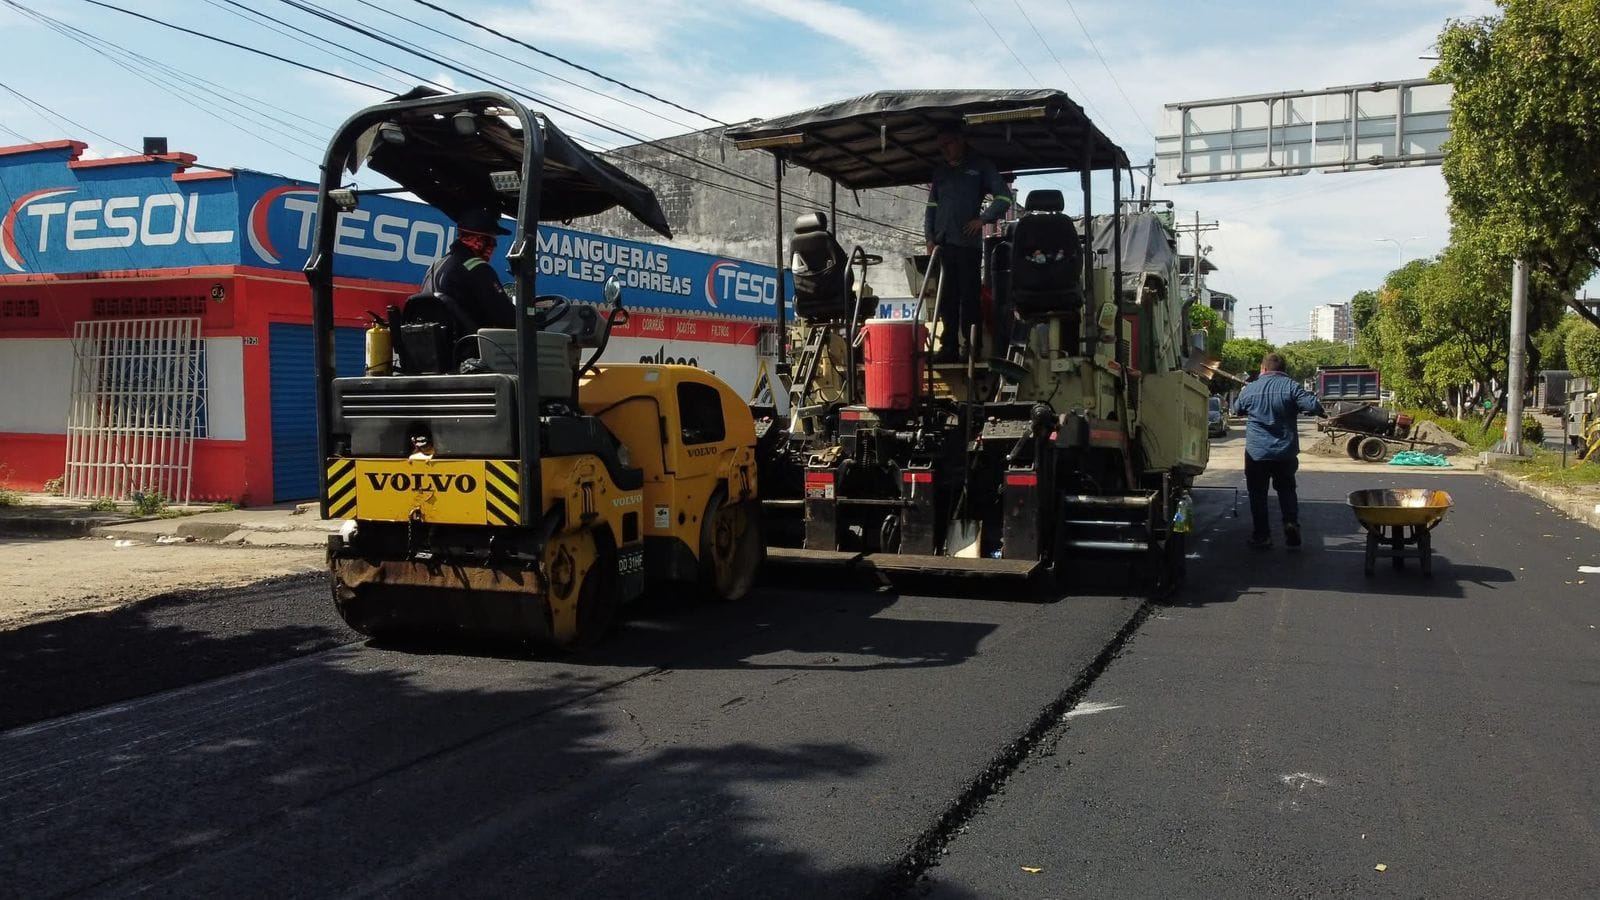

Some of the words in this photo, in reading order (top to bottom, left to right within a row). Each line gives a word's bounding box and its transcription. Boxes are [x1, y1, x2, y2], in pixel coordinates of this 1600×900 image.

[28, 192, 234, 252] TESOL
[535, 230, 669, 273] MANGUERAS
[613, 268, 692, 296] CORREAS
[687, 447, 718, 458] VOLVO
[365, 473, 477, 494] VOLVO
[612, 495, 643, 507] VOLVO
